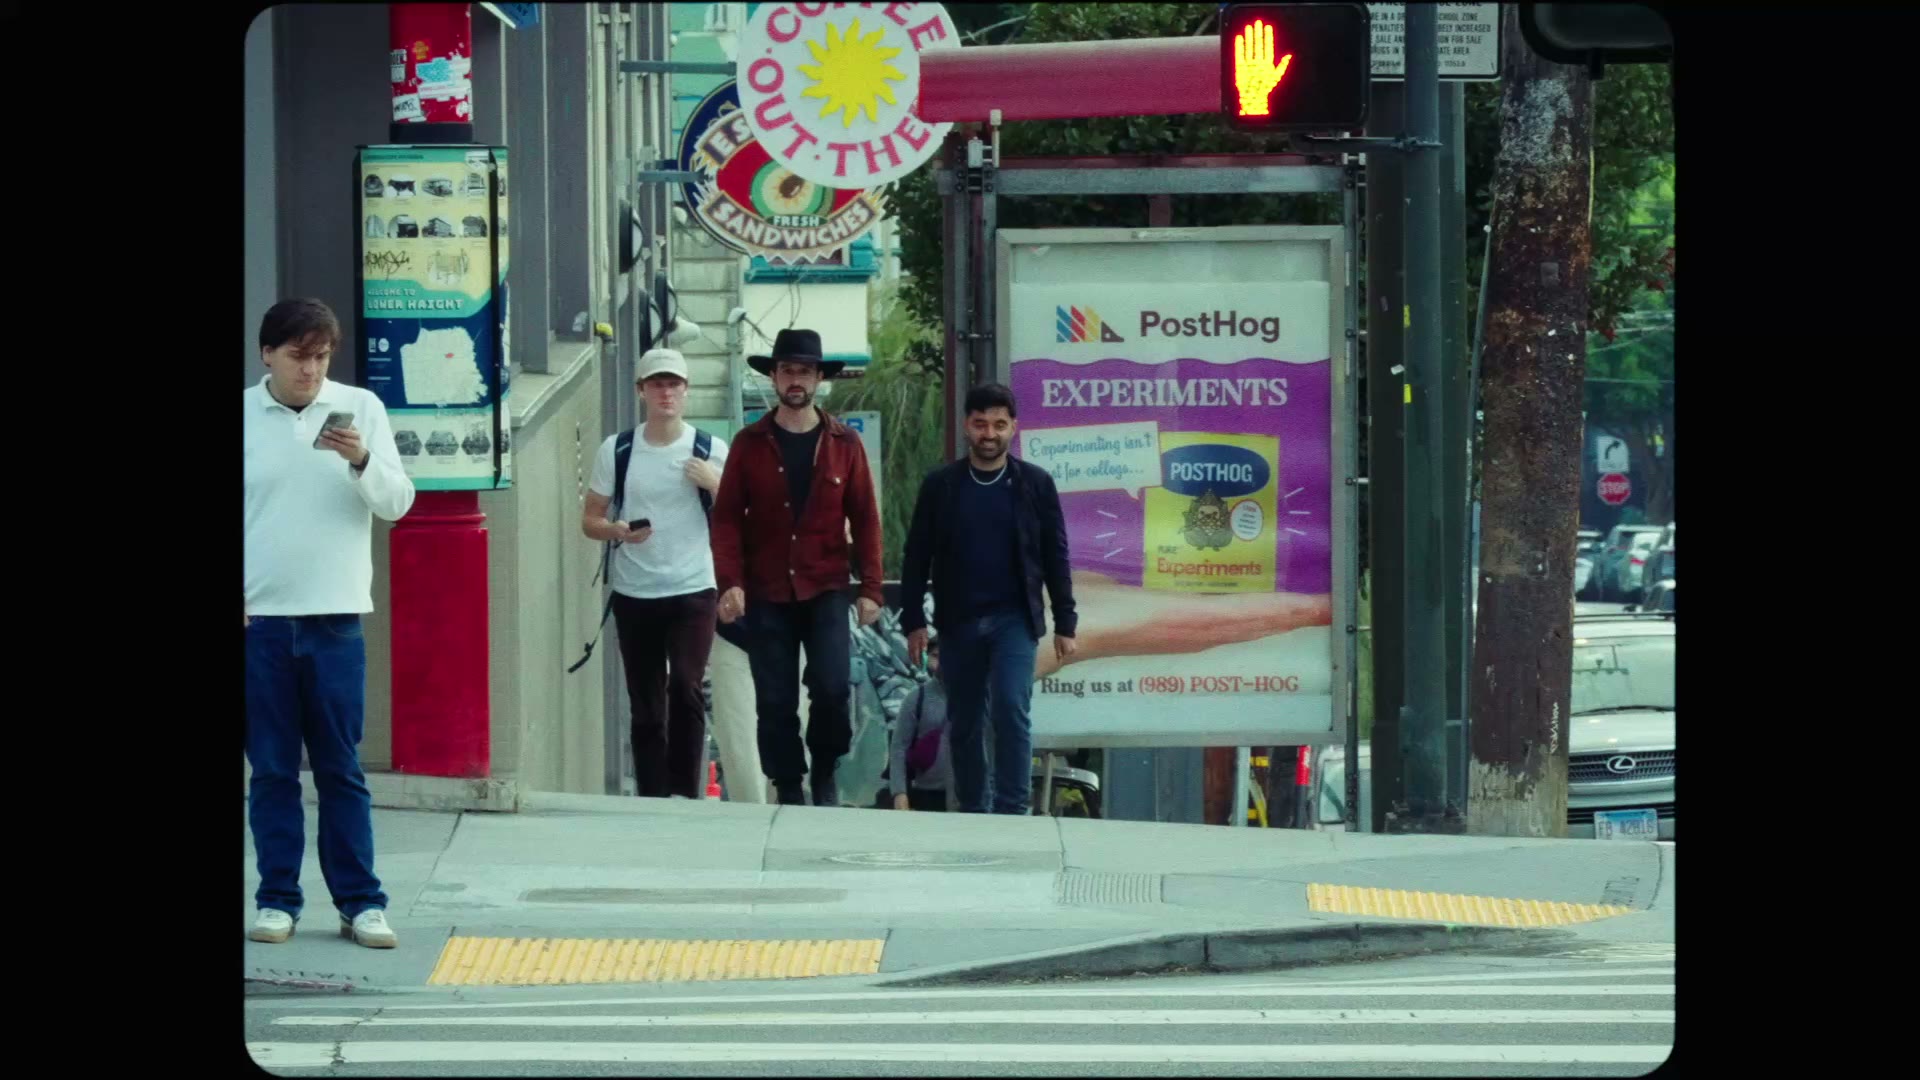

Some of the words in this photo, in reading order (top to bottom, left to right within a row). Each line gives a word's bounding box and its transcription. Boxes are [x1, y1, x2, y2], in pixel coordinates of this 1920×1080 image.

[766, 2, 947, 51] COEE
[1439, 12, 1460, 22] CHOOL
[1454, 23, 1492, 33] INCREASED
[1465, 34, 1482, 44] SALE
[1370, 46, 1390, 55] RUGS
[747, 57, 819, 160] OUT
[826, 104, 938, 177] THE
[712, 201, 870, 248] SANDWICHES
[772, 214, 820, 227] FRESH
[404, 288, 417, 297] TO
[367, 299, 404, 311] LOWER
[408, 299, 465, 311] HAIGHT
[1139, 310, 1281, 344] PostHog
[1041, 377, 1289, 408] EXPERIMENTS
[1029, 436, 1121, 460] Experimenting
[1063, 461, 1080, 483] for
[1170, 461, 1253, 483] POSTHOG
[1599, 481, 1629, 494] STOP
[1157, 557, 1263, 578] Experiments
[1040, 677, 1085, 698] Ring
[1091, 681, 1112, 693] us
[1117, 678, 1133, 693] at
[1138, 676, 1185, 694] (989)
[1190, 676, 1299, 692] POST-HOG
